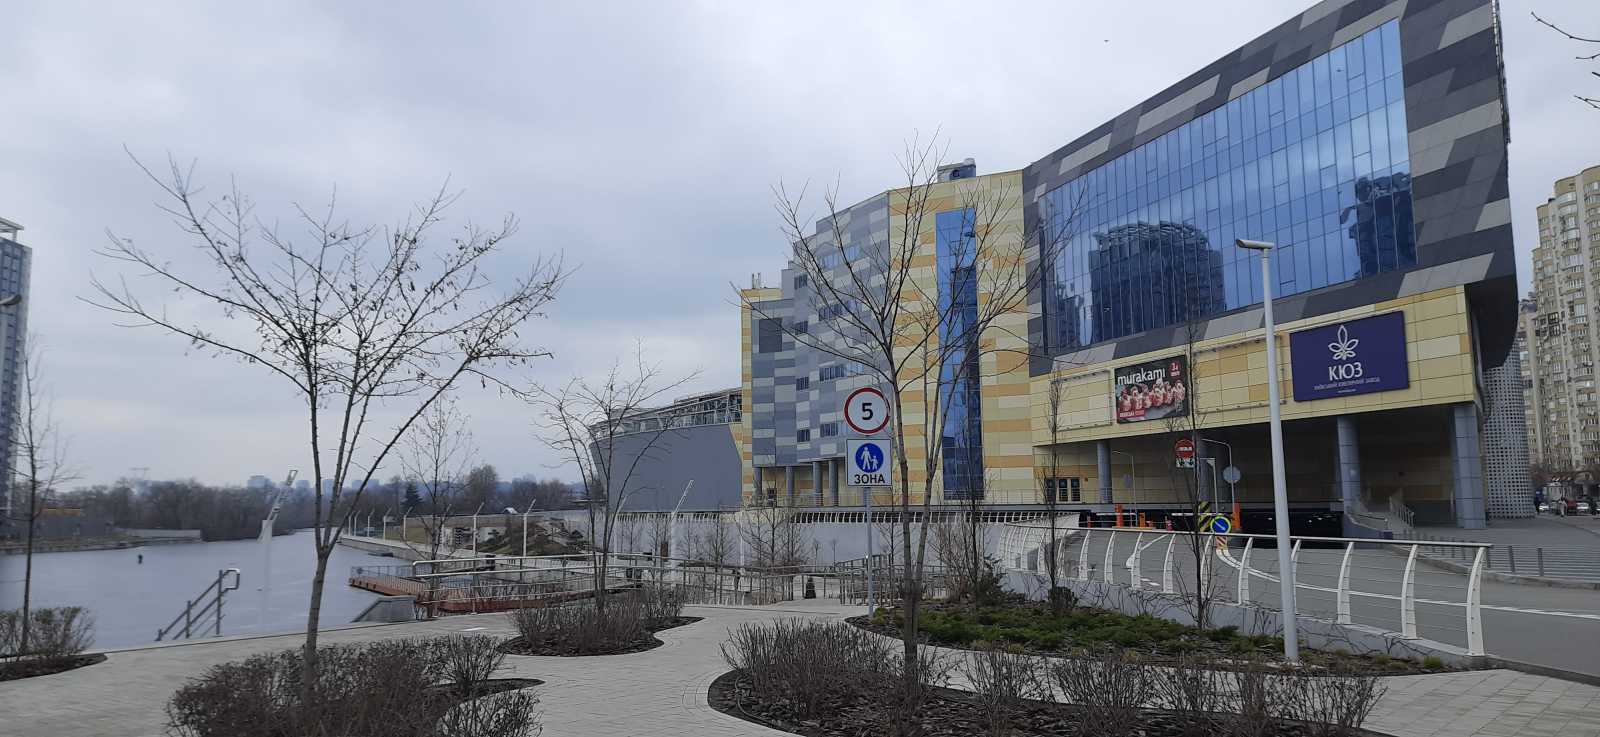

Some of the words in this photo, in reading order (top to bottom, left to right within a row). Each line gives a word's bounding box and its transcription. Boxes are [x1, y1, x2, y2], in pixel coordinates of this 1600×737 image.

[1117, 368, 1166, 385] murakami
[1328, 362, 1363, 381] КЮЗ
[862, 402, 874, 421] 5
[854, 473, 886, 484] ЗОНА
